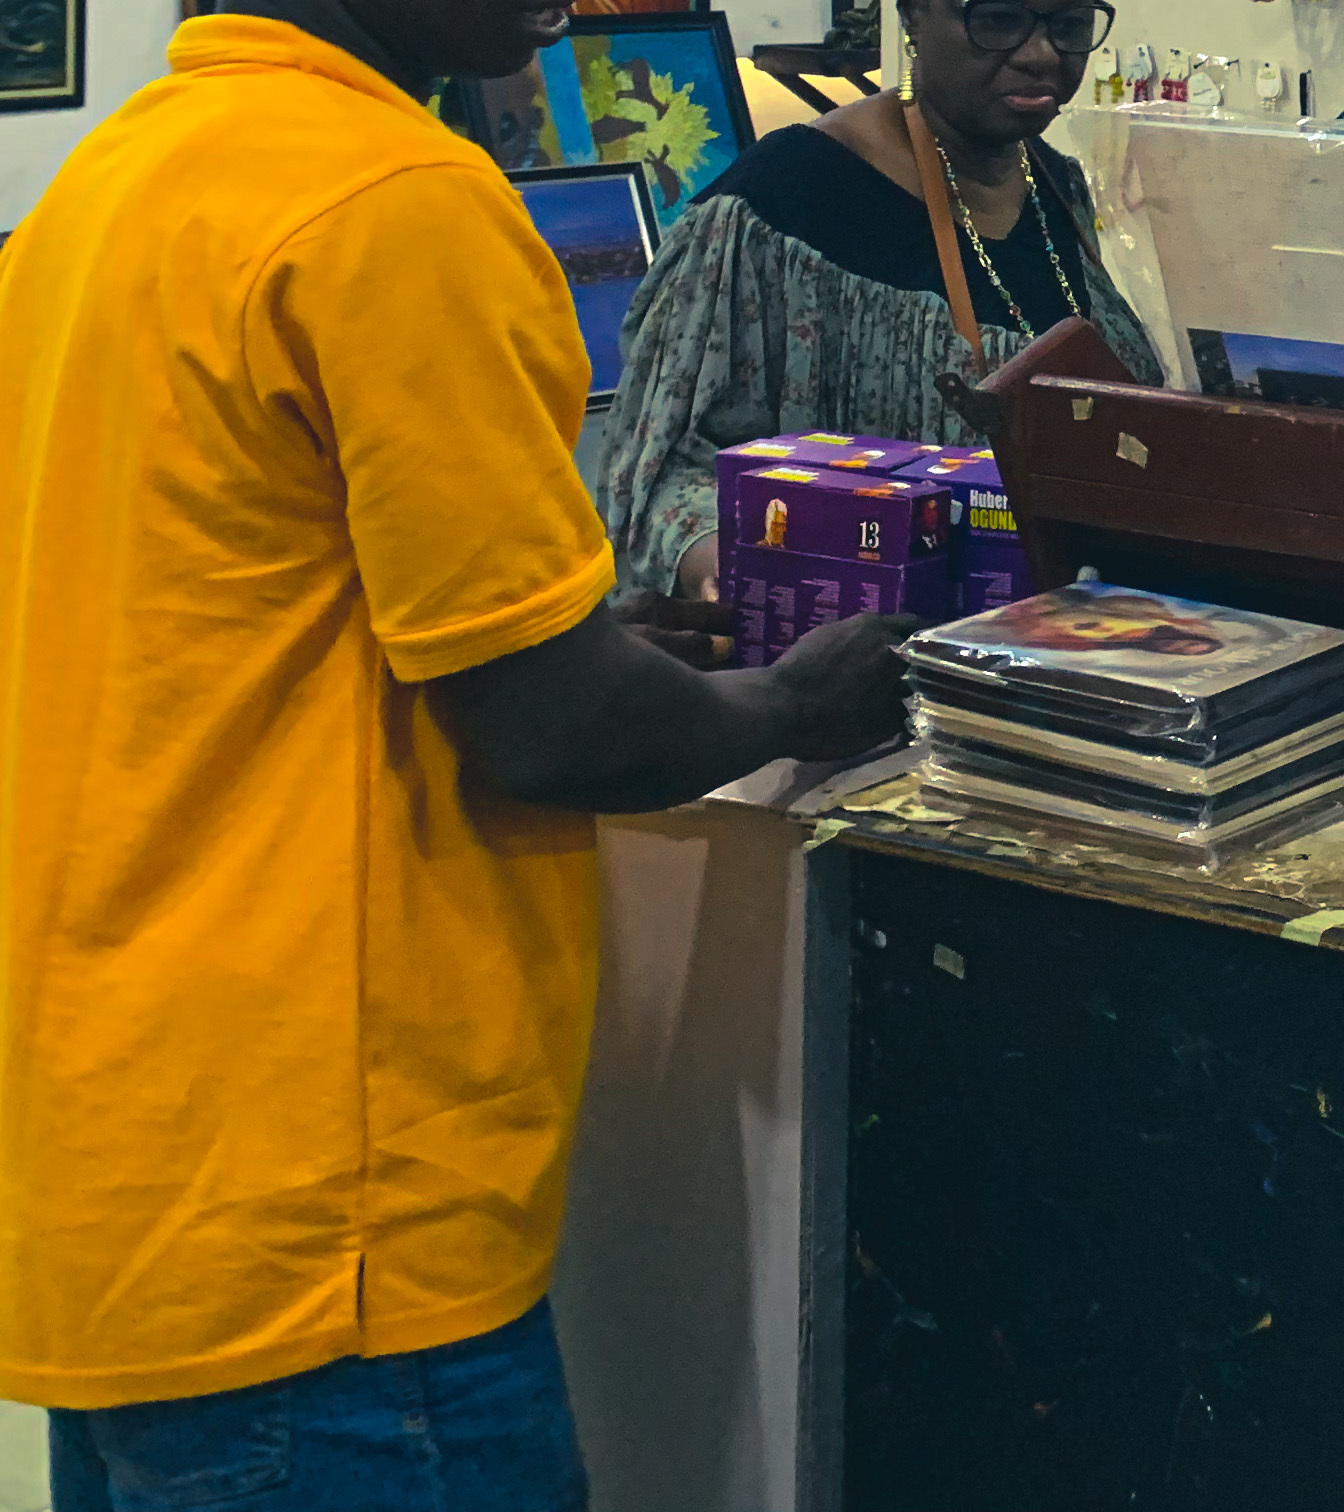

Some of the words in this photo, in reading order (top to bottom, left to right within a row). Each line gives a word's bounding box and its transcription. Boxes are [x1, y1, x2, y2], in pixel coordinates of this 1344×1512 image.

[969, 488, 1011, 510] Huber
[969, 508, 1018, 532] OGUND
[858, 520, 880, 550] 13
